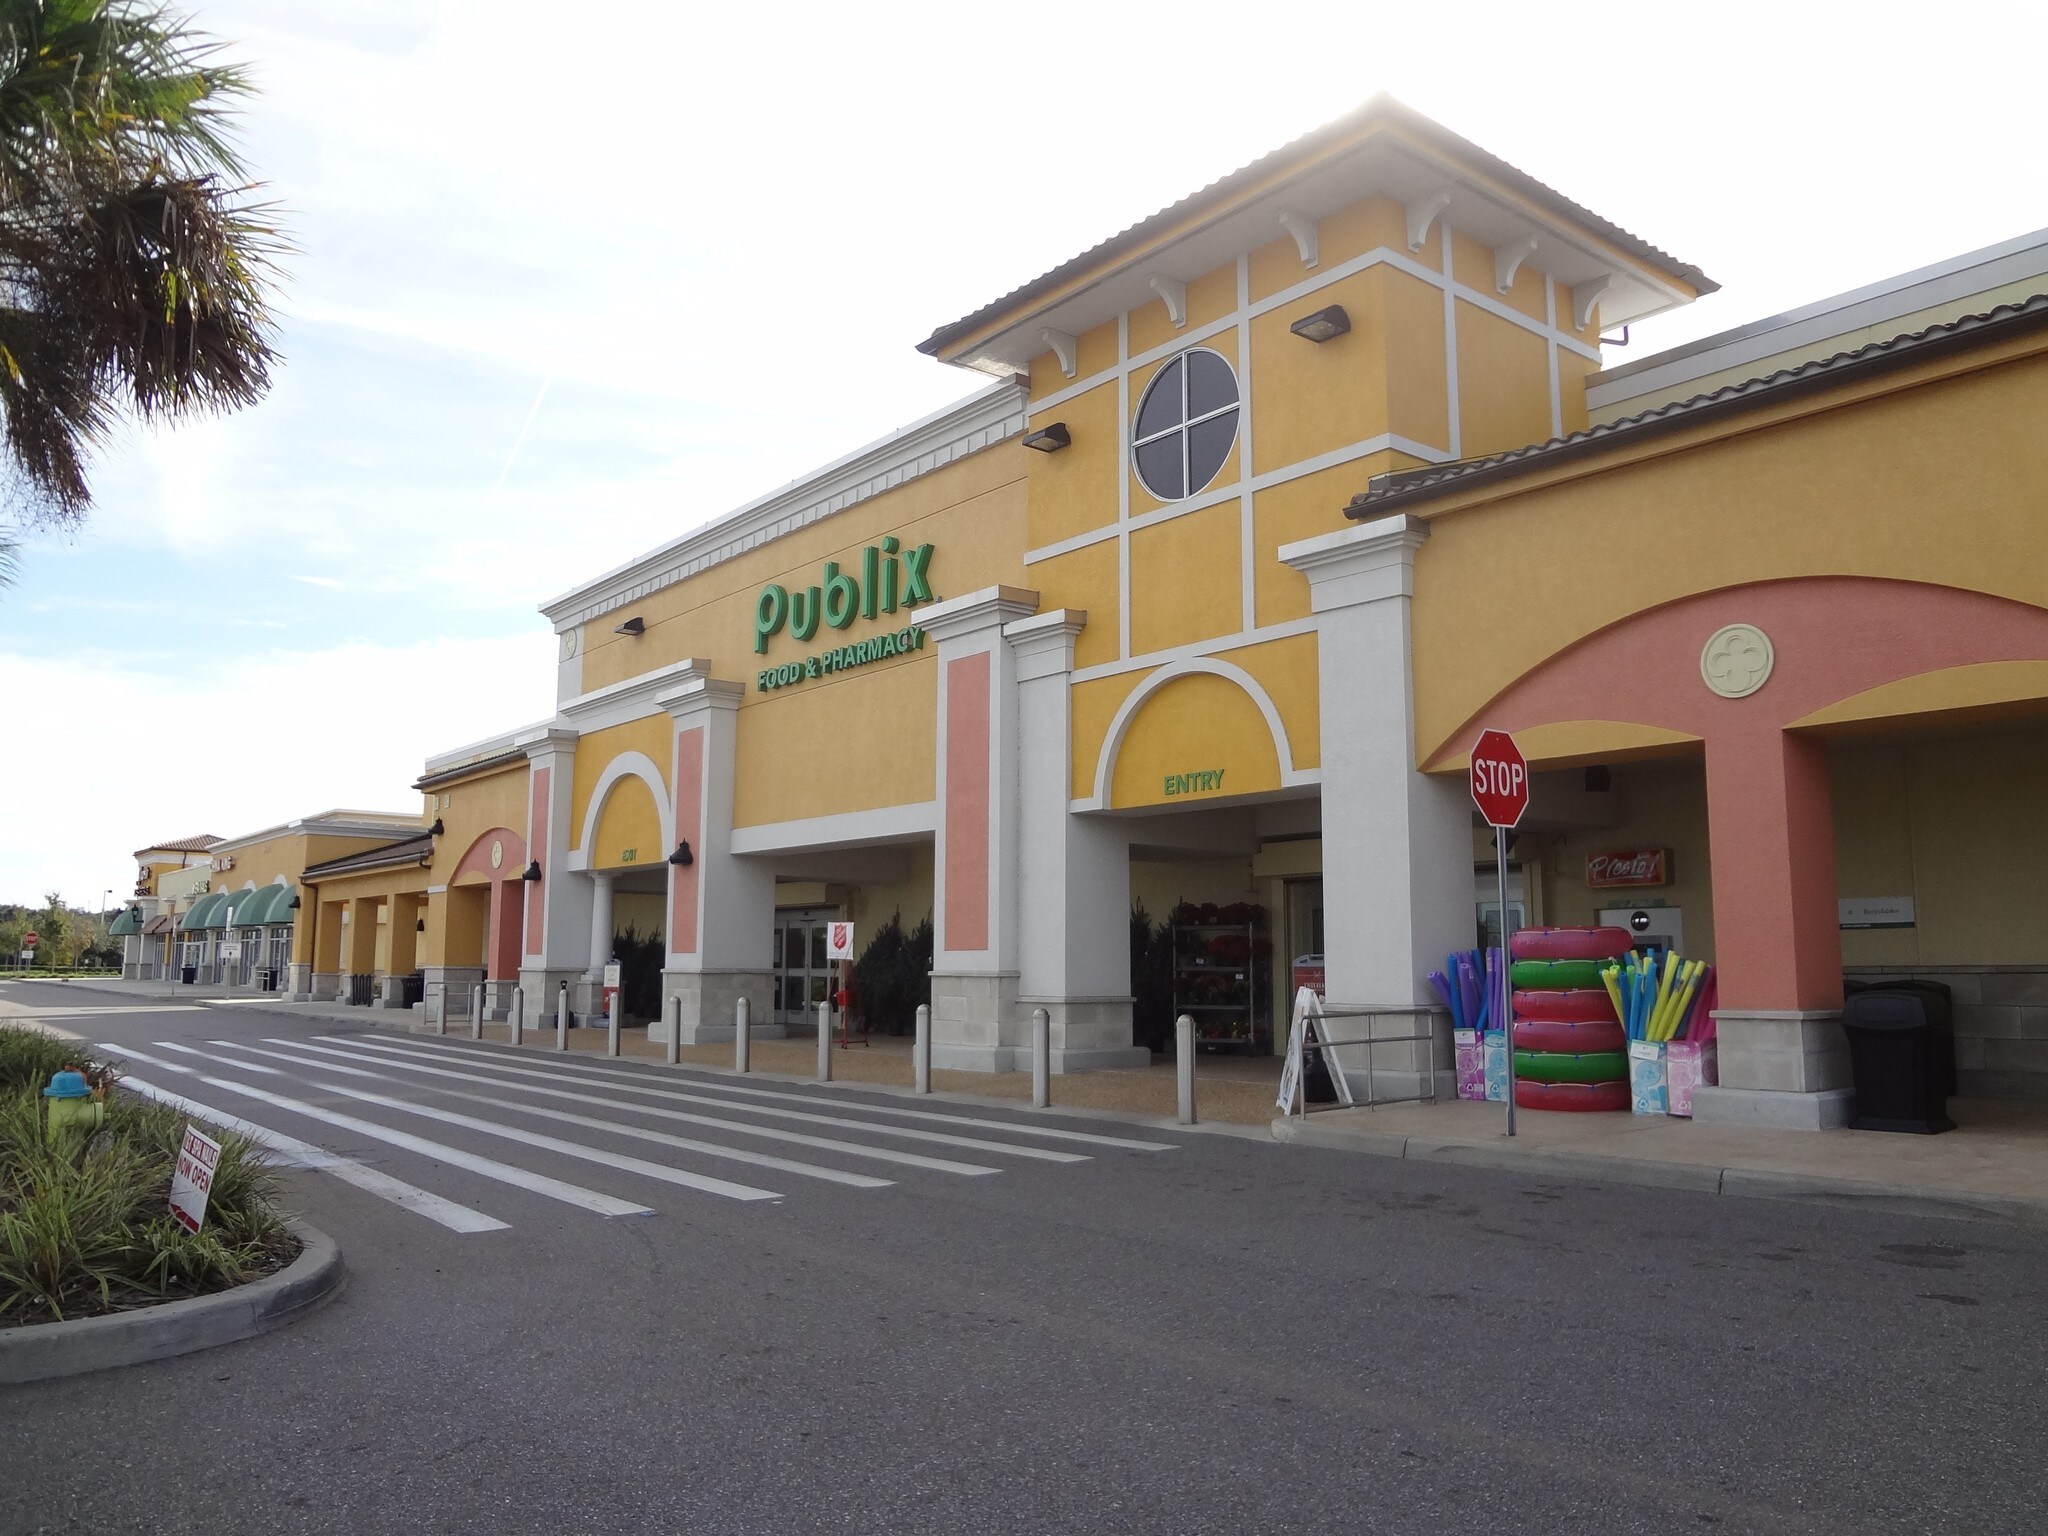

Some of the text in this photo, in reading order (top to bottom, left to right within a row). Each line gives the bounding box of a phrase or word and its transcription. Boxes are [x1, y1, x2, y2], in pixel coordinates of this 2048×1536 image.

[758, 626, 925, 692] FOOD & PHARMACY
[1164, 768, 1225, 796] ENTRY
[1475, 758, 1523, 797] STOP
[178, 1156, 212, 1194] NOW OPEN
